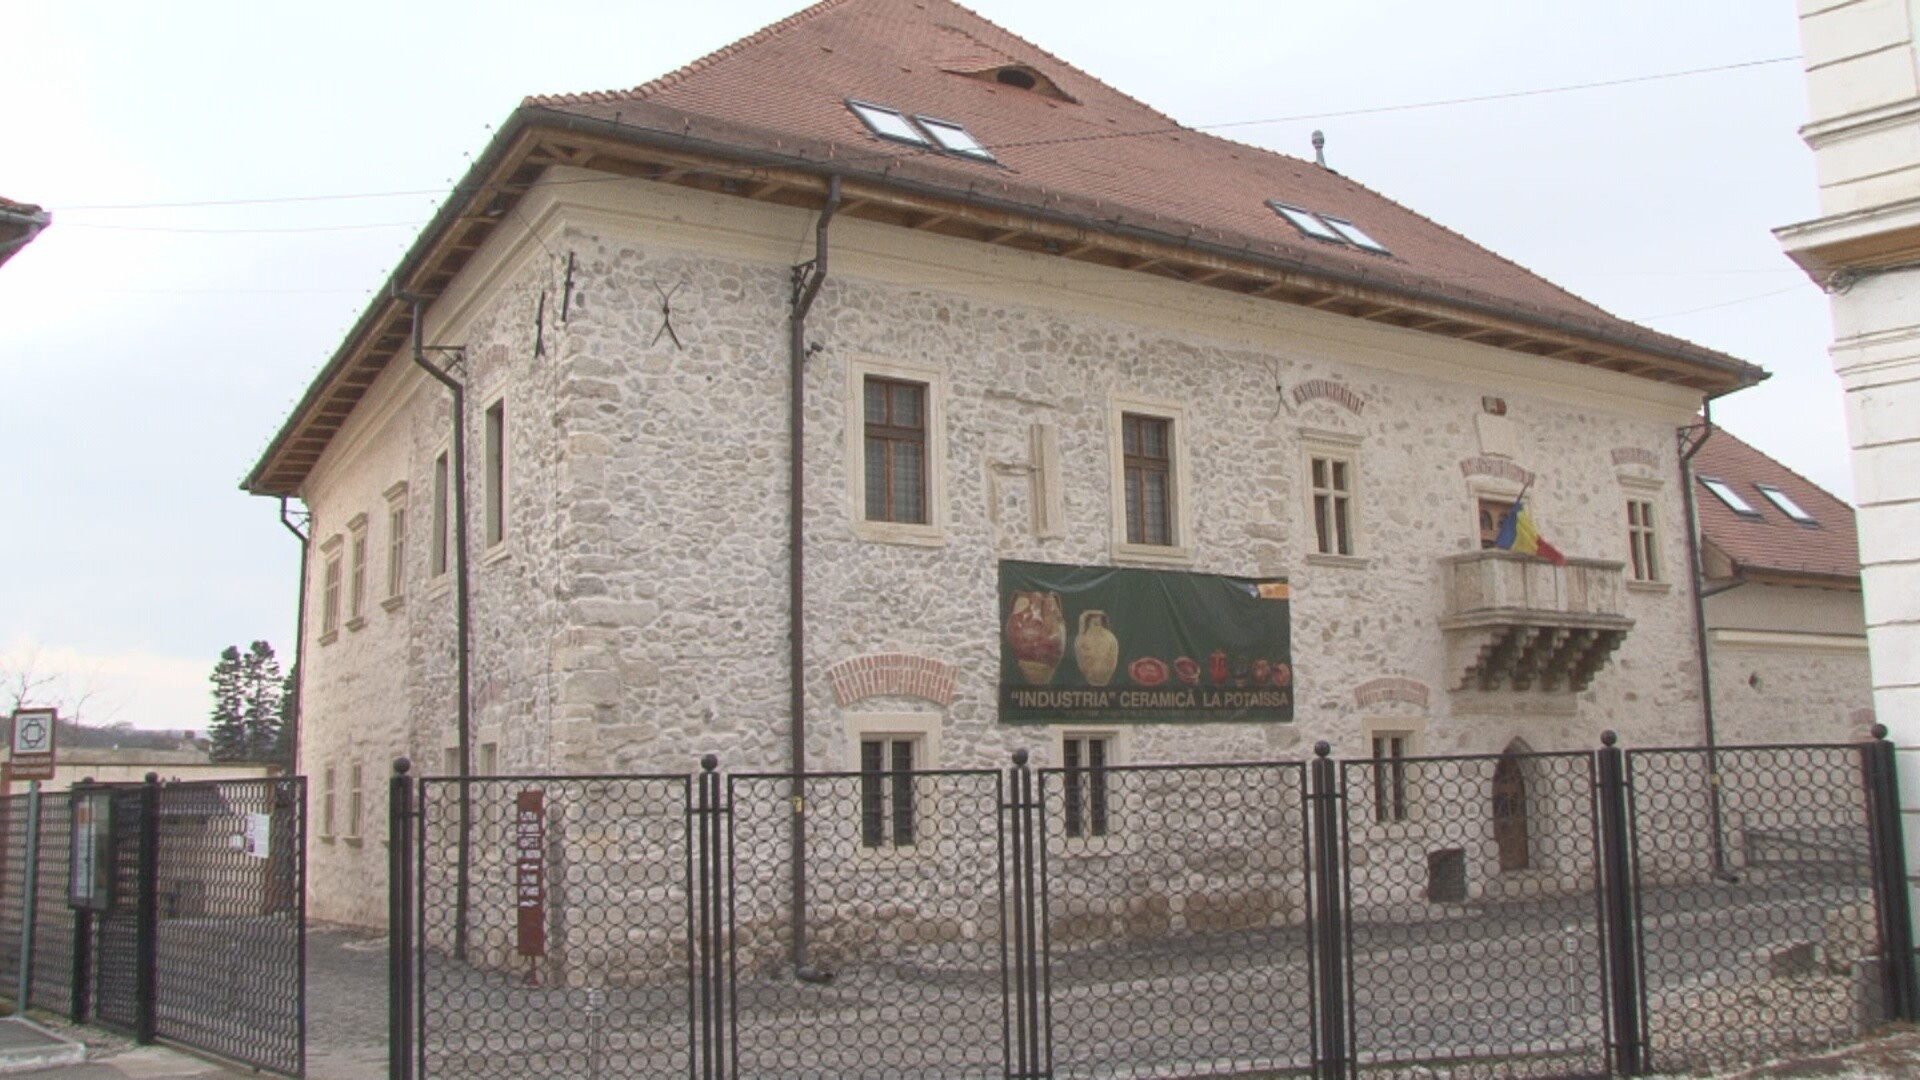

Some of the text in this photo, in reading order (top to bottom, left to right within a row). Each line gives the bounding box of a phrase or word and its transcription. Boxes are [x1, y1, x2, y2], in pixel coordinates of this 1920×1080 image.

[1120, 689, 1196, 707] CERAMICĂ
[1203, 692, 1221, 707] LA
[1224, 691, 1289, 707] POTAISSA
